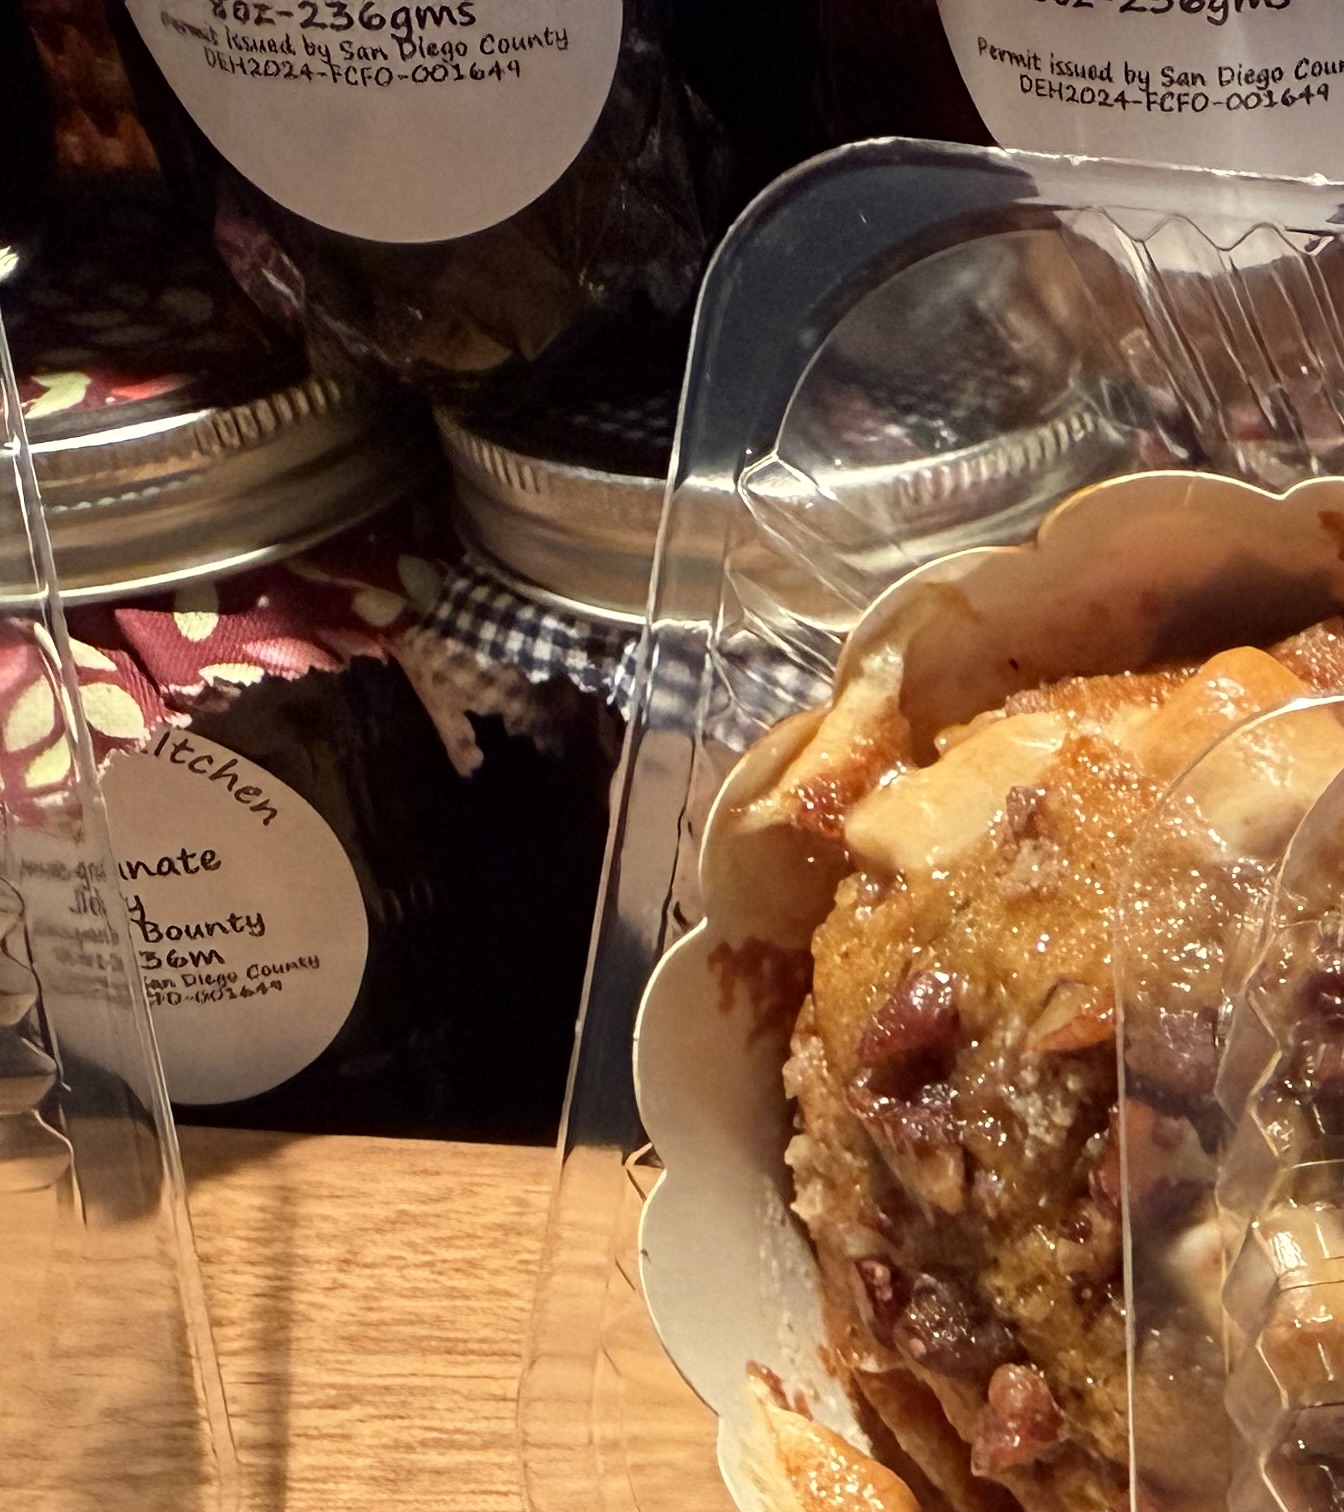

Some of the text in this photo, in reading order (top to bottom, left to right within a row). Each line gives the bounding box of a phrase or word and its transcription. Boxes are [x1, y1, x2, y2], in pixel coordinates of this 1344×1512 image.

[302, 34, 331, 63] by
[339, 40, 388, 61] San
[479, 27, 569, 55] County
[977, 36, 1042, 72] Permit
[1049, 53, 1114, 83] issued
[1124, 61, 1150, 92] by
[1160, 66, 1206, 88] San
[1218, 63, 1284, 90] Diego
[141, 730, 278, 826] itchen
[141, 912, 266, 943] Bounty
